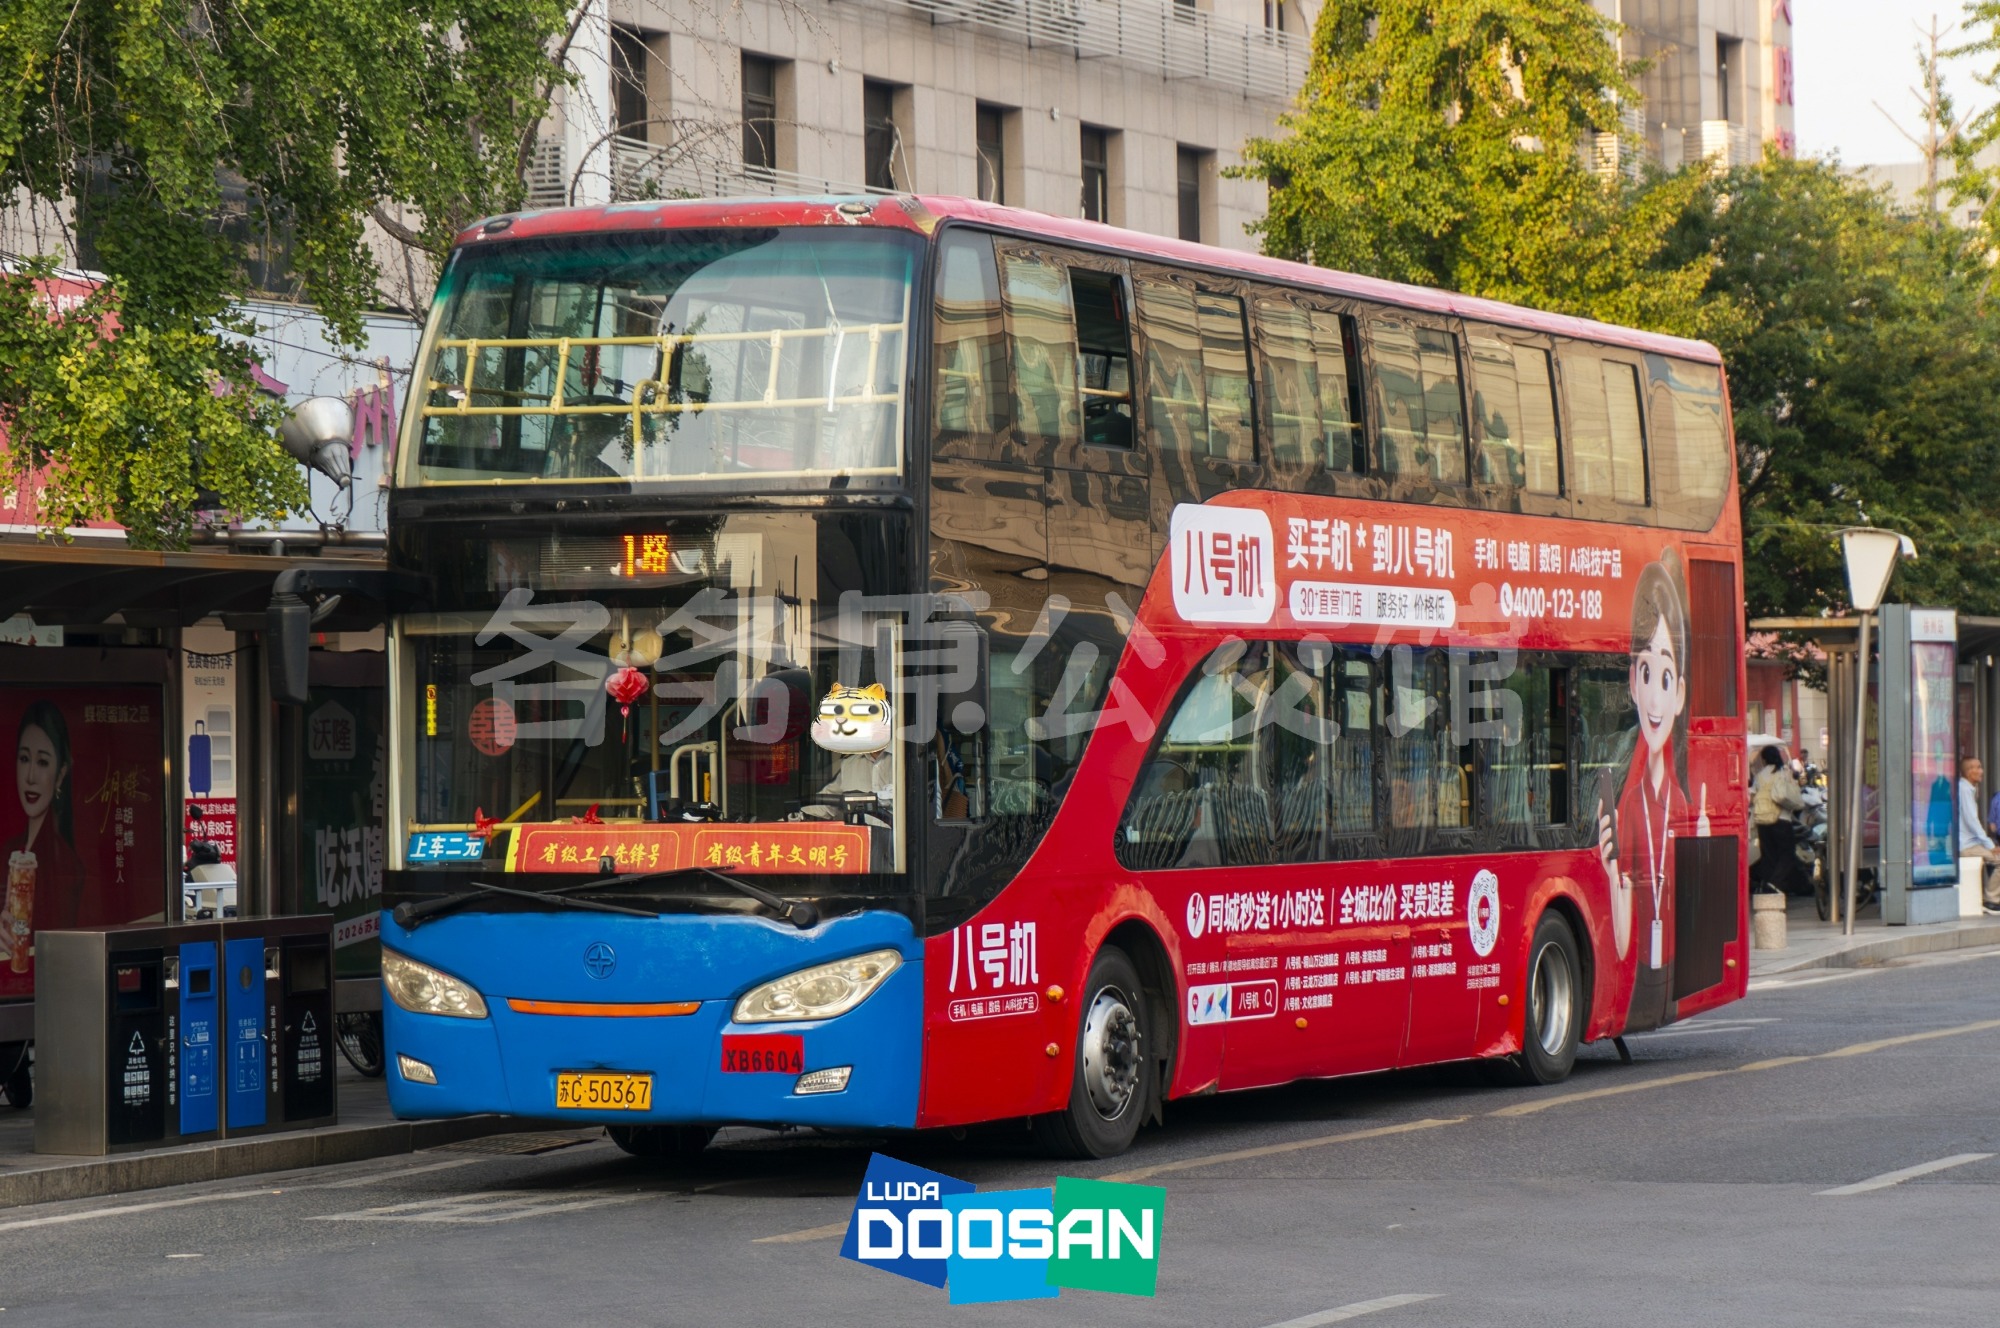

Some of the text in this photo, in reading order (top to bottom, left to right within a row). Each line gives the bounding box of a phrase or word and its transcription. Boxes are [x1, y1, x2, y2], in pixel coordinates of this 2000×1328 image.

[624, 535, 669, 575] 1路
[1184, 530, 1264, 597] 八号机
[1475, 538, 1498, 569] 手机
[1507, 540, 1530, 572] 电脑
[1539, 543, 1561, 575] 数码
[1376, 592, 1408, 619] 服务好
[1414, 594, 1445, 620] 价格低
[1513, 586, 1602, 620] 4000-123-188
[313, 719, 352, 752] 沃隆
[410, 836, 481, 858] 上车二元
[704, 842, 849, 869] 省级青年文明号
[1208, 887, 1325, 934] 同城秒送1小时达
[1340, 880, 1455, 924] 全城比价 买贵退差
[949, 921, 1039, 993] 八号机
[953, 1005, 966, 1018] 手机
[1239, 992, 1260, 1010] 八号机
[726, 1050, 803, 1072] XB6604
